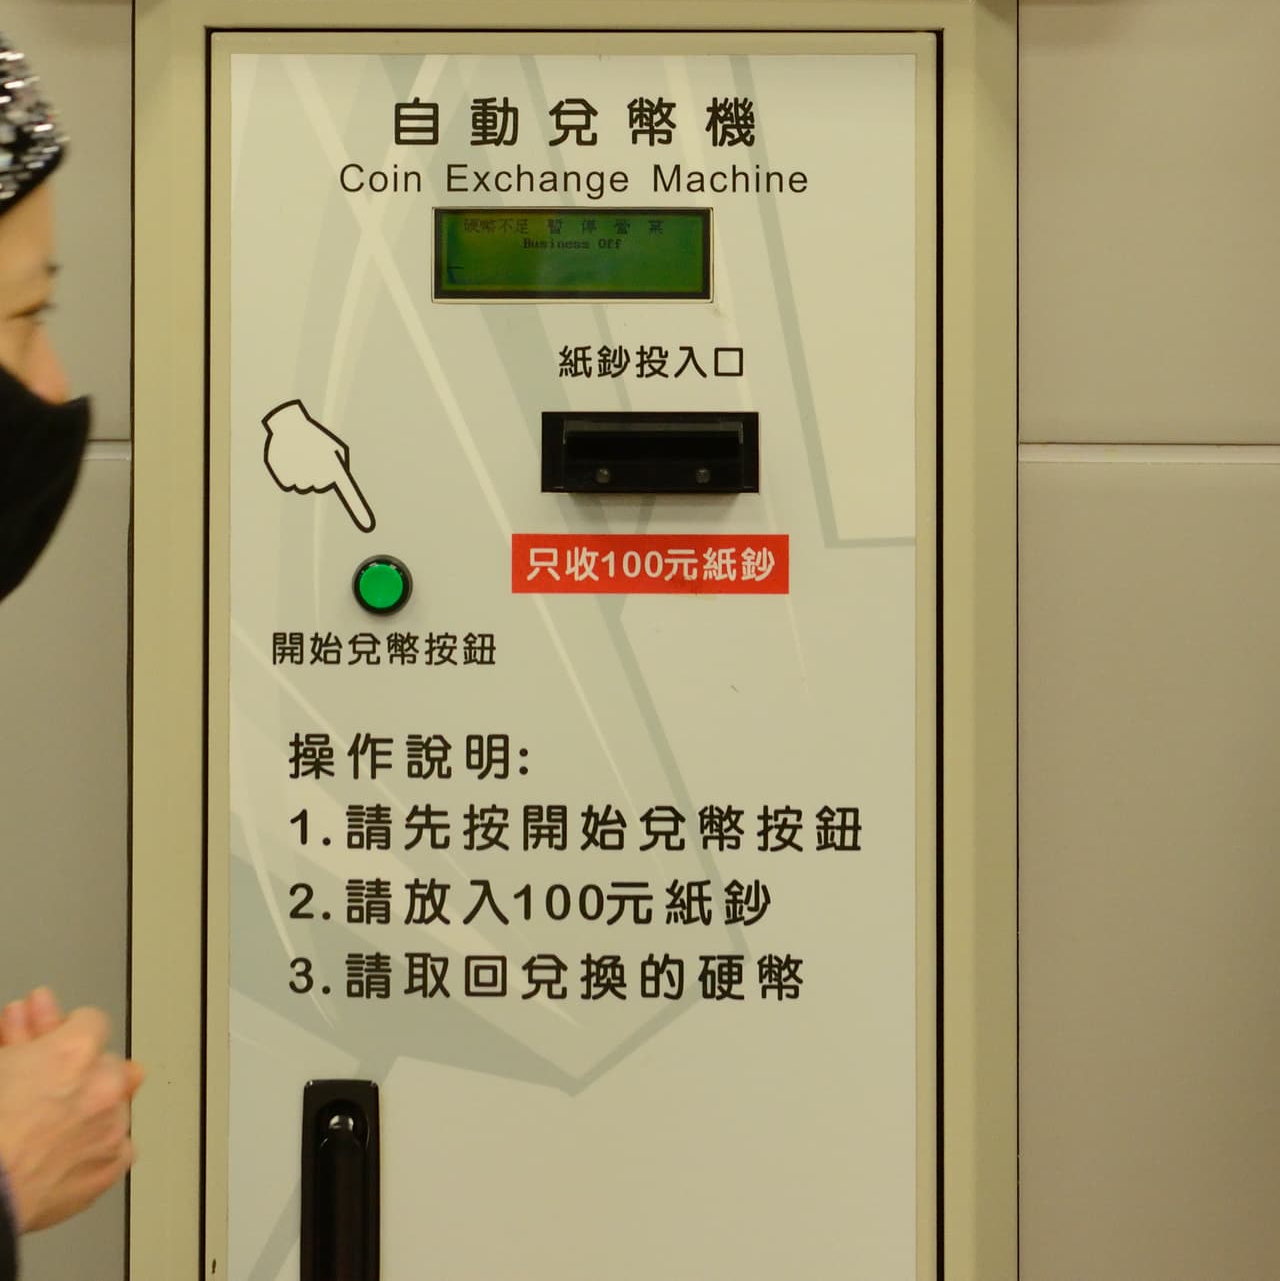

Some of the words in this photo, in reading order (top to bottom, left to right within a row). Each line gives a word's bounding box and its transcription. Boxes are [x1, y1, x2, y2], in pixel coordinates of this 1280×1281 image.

[395, 97, 757, 147] 自動兌幣機
[339, 164, 422, 194] Coin
[446, 164, 629, 200] Exchange
[653, 164, 808, 194] Machine
[558, 346, 744, 379] 紙鈔投入口
[526, 547, 776, 583] 只收100元紙鈔
[272, 631, 497, 668] 開始兌幣按鈕
